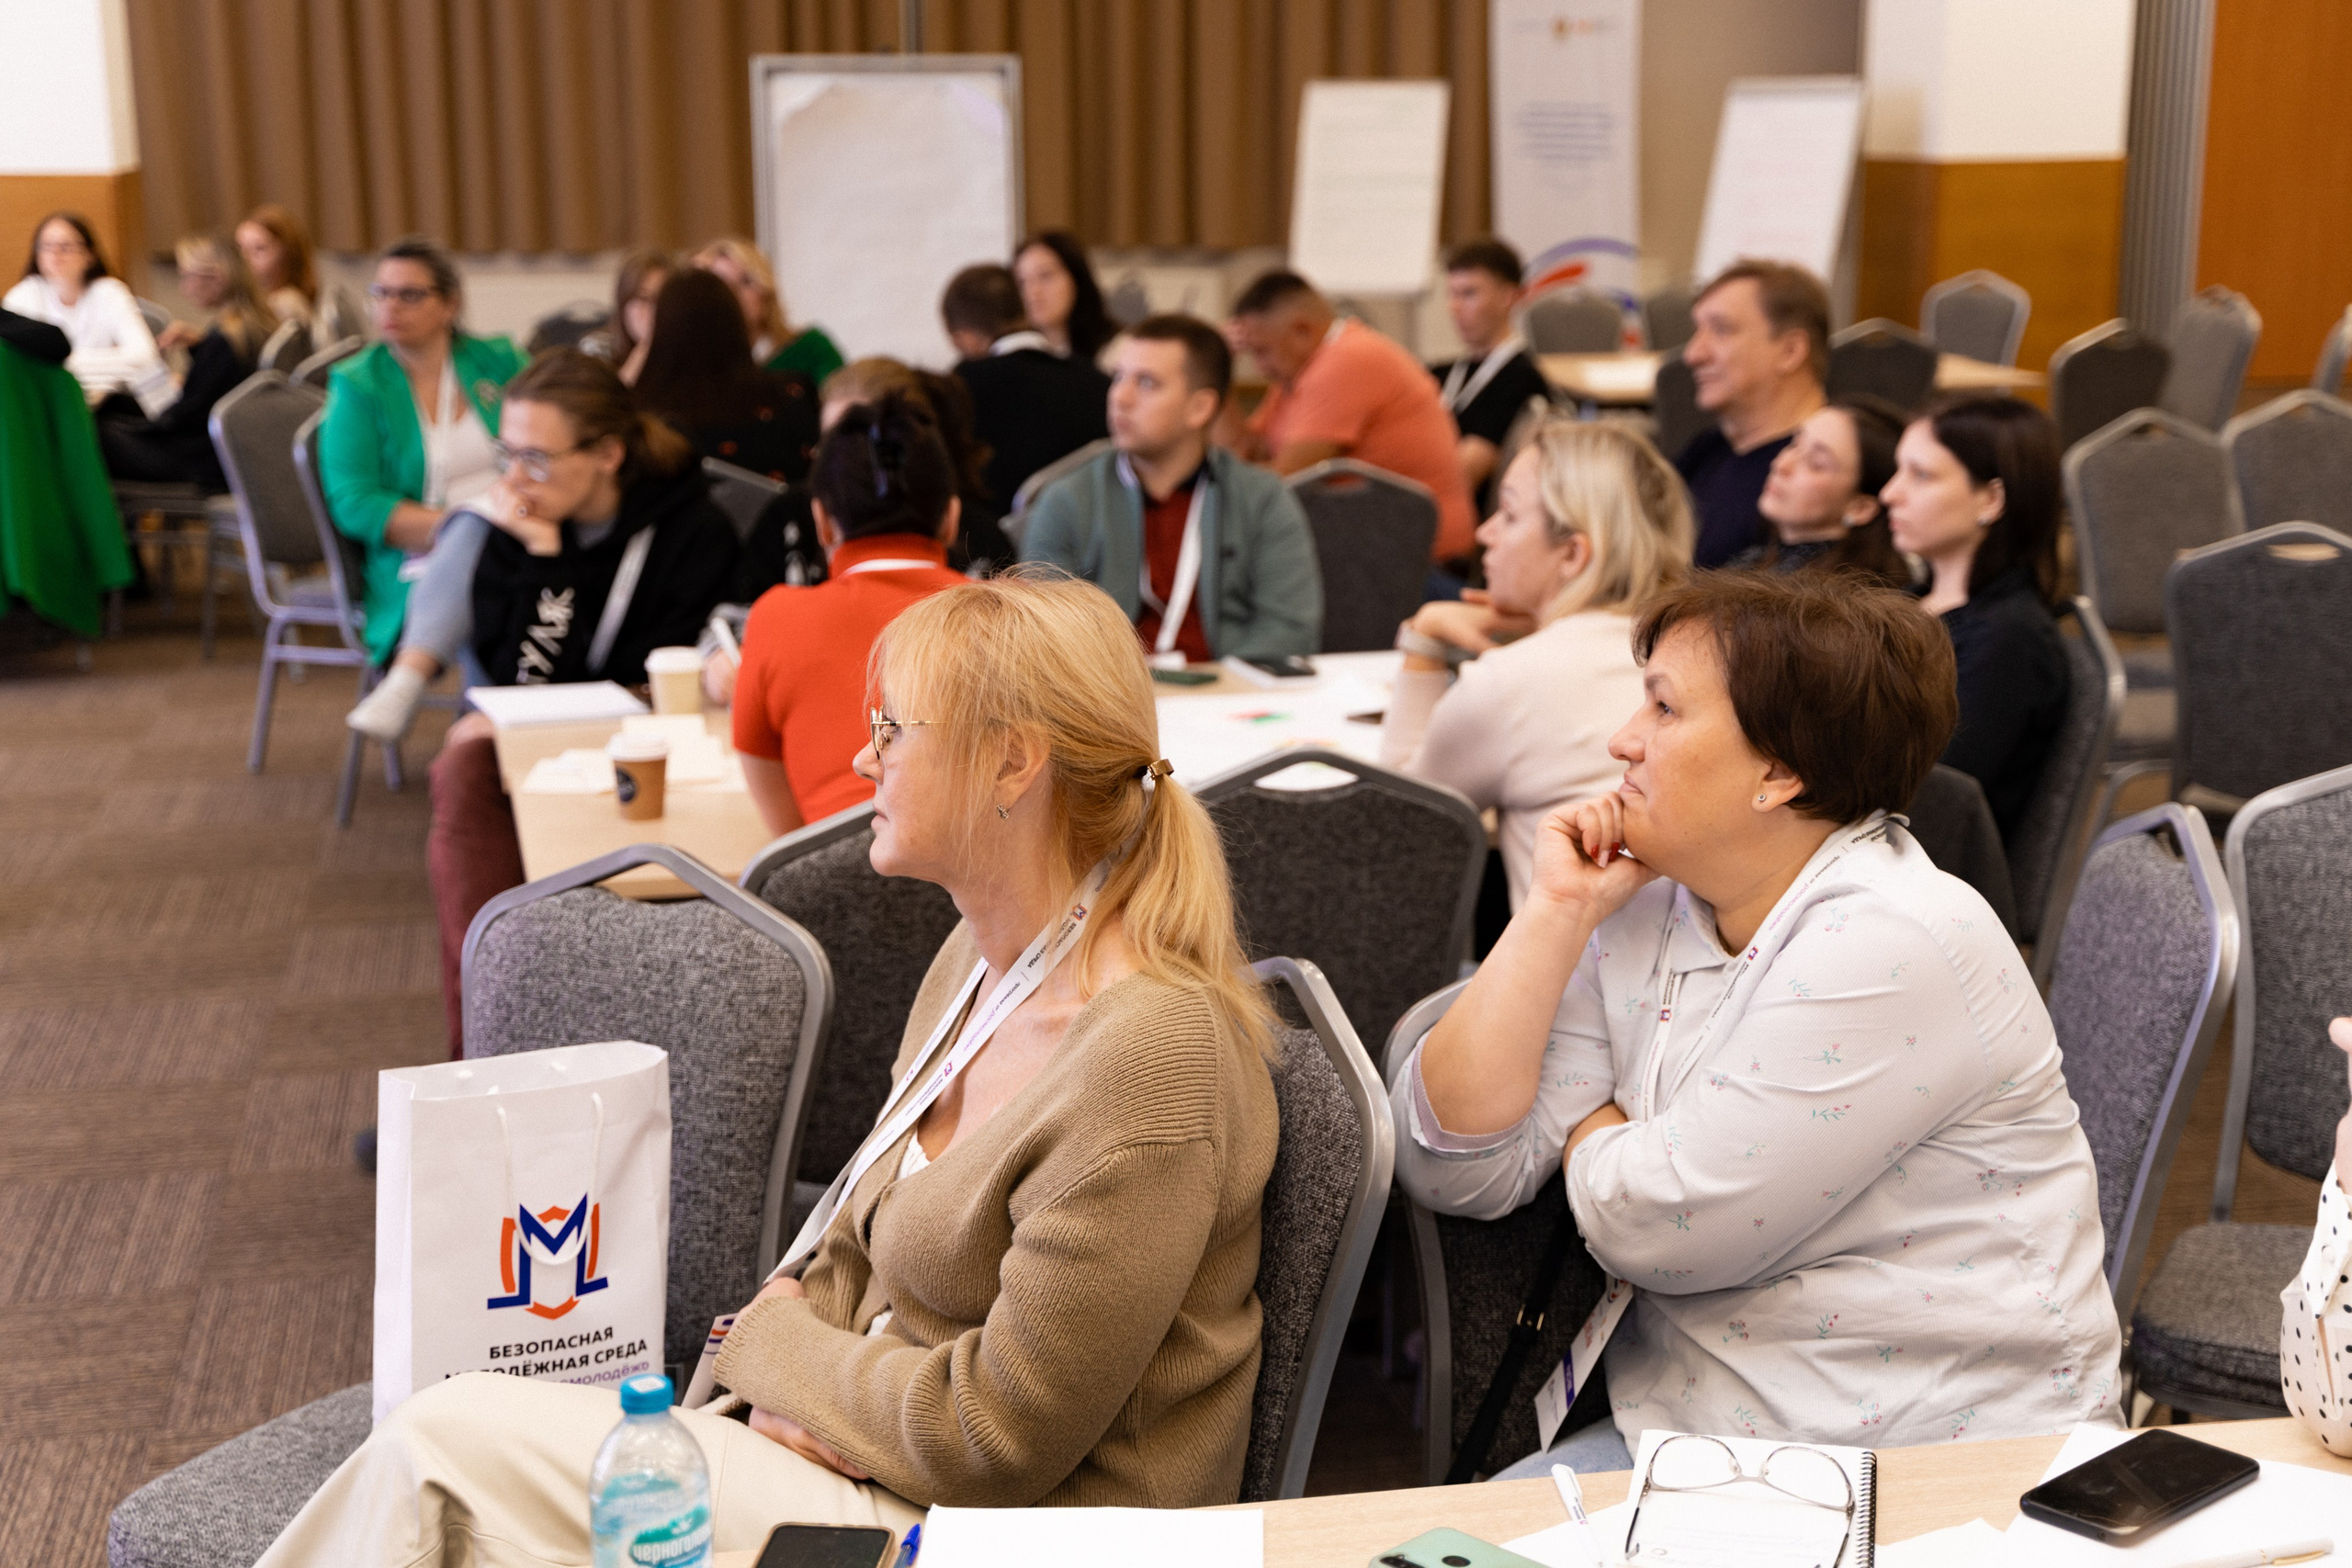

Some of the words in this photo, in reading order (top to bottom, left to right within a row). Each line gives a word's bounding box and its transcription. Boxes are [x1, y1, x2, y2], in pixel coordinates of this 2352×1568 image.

[445, 1354, 589, 1379] ДЁЖНАЯ
[594, 1338, 647, 1363] СРЕДА
[490, 1326, 613, 1359] БЕЗОПАСНАЯ
